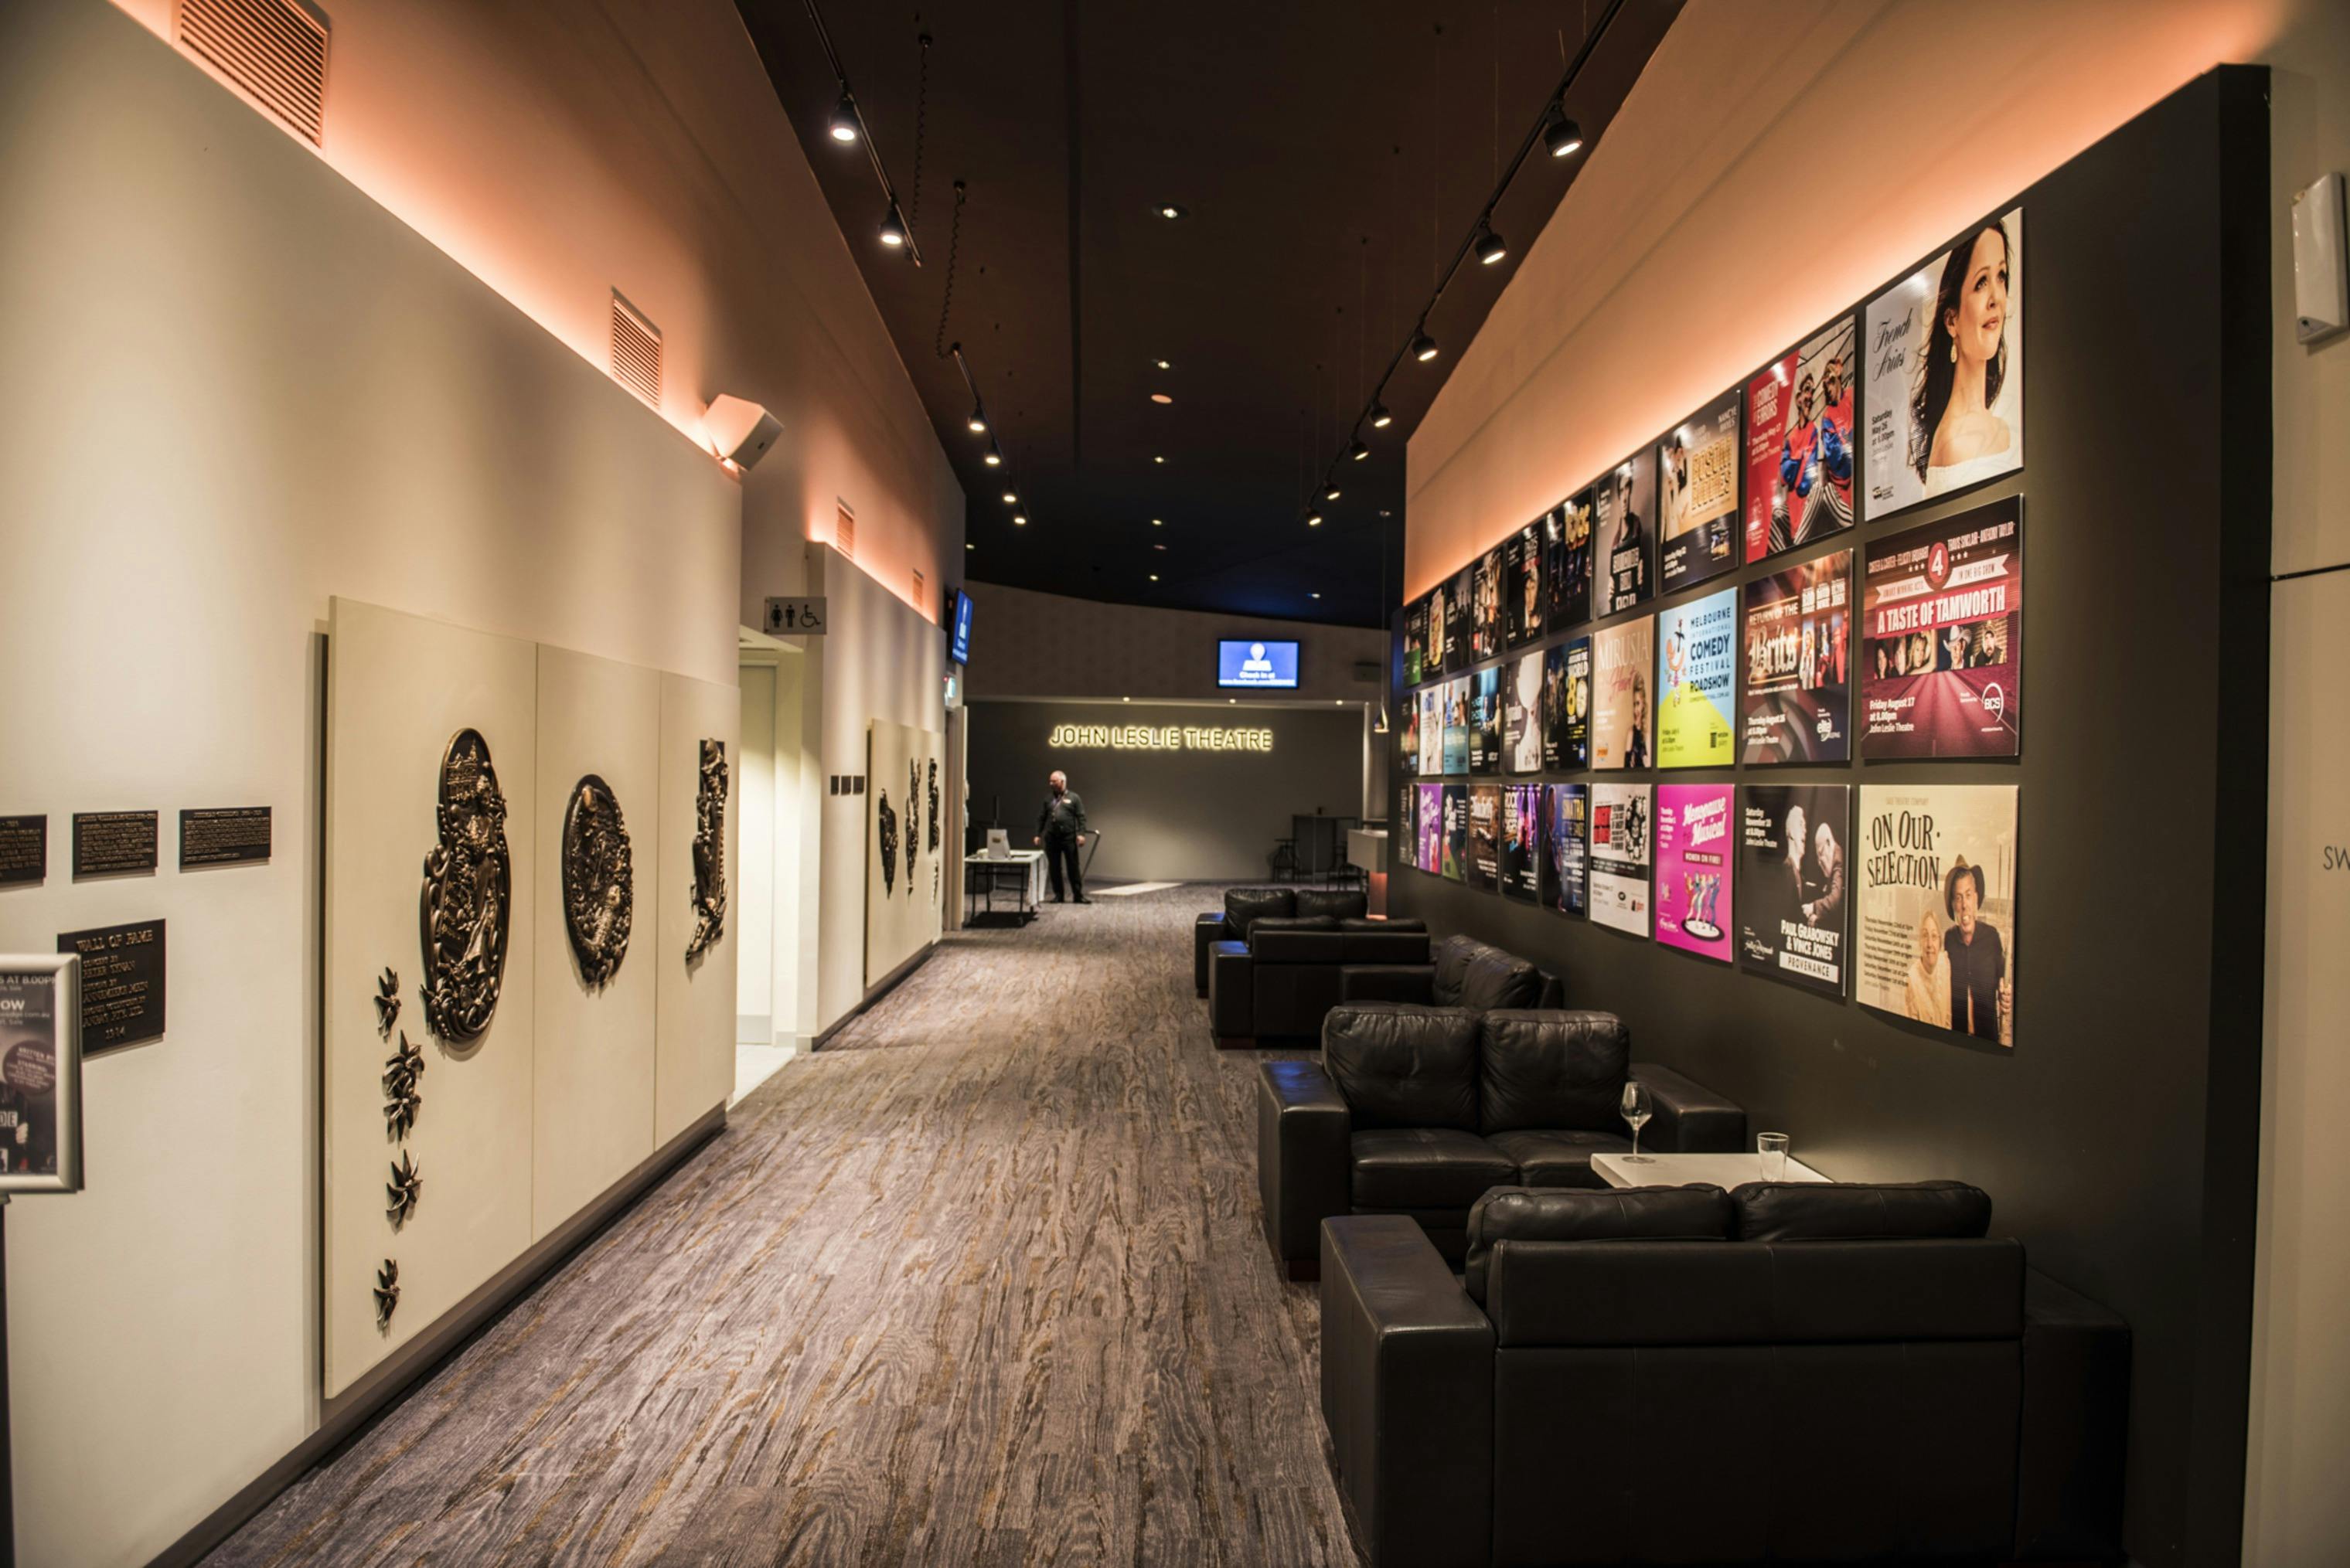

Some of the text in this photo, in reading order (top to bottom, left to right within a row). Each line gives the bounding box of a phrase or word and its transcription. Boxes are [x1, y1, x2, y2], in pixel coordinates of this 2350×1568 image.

[1931, 549, 1943, 577] 4
[1691, 607, 1731, 629] MELBOURNE
[1785, 603, 1798, 617] THE
[1877, 585, 2006, 634] A TASTE OF TAMWORTH
[1598, 631, 1650, 671] MIRUSIA
[1691, 634, 1731, 661] COMEDY
[1690, 658, 1730, 675] FESTIVAL
[1690, 673, 1730, 692] ROADSHOW
[1869, 698, 1888, 711] Friday
[1888, 698, 1907, 710] August
[1049, 726, 1273, 750] JOHN LESLIE THEATRE
[1895, 723, 1915, 732] Theatre
[1691, 812, 1727, 847] Musical
[1872, 811, 1933, 851] ON OUR
[1867, 851, 1940, 890] SELECTION
[77, 930, 154, 952] WALL OF FAME
[1793, 937, 1812, 956] VINCE
[1812, 942, 1834, 961] JONES
[1787, 957, 1830, 978] PROVENANCE
